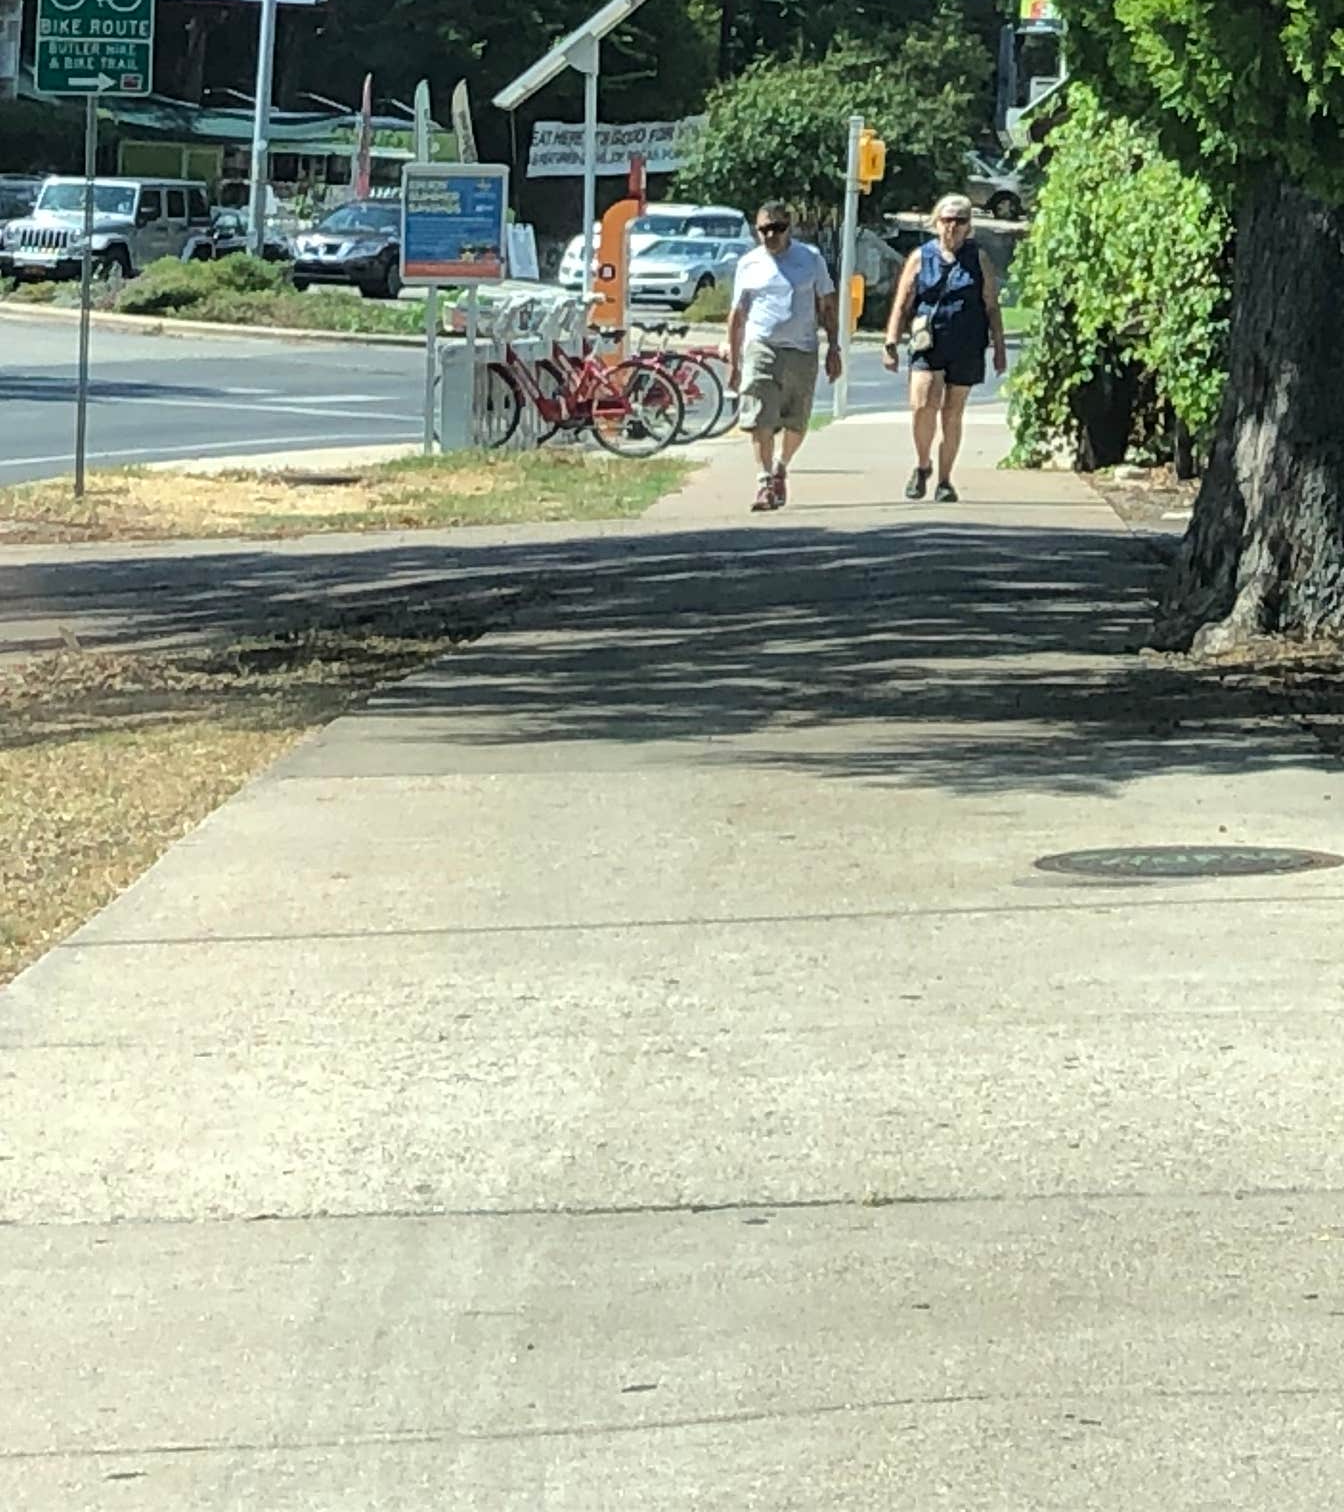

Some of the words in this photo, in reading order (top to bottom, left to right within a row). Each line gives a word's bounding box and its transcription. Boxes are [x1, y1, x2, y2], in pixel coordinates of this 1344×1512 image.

[40, 18, 82, 35] BIKE
[89, 18, 150, 37] ROUTE
[100, 57, 139, 71] TRAIL
